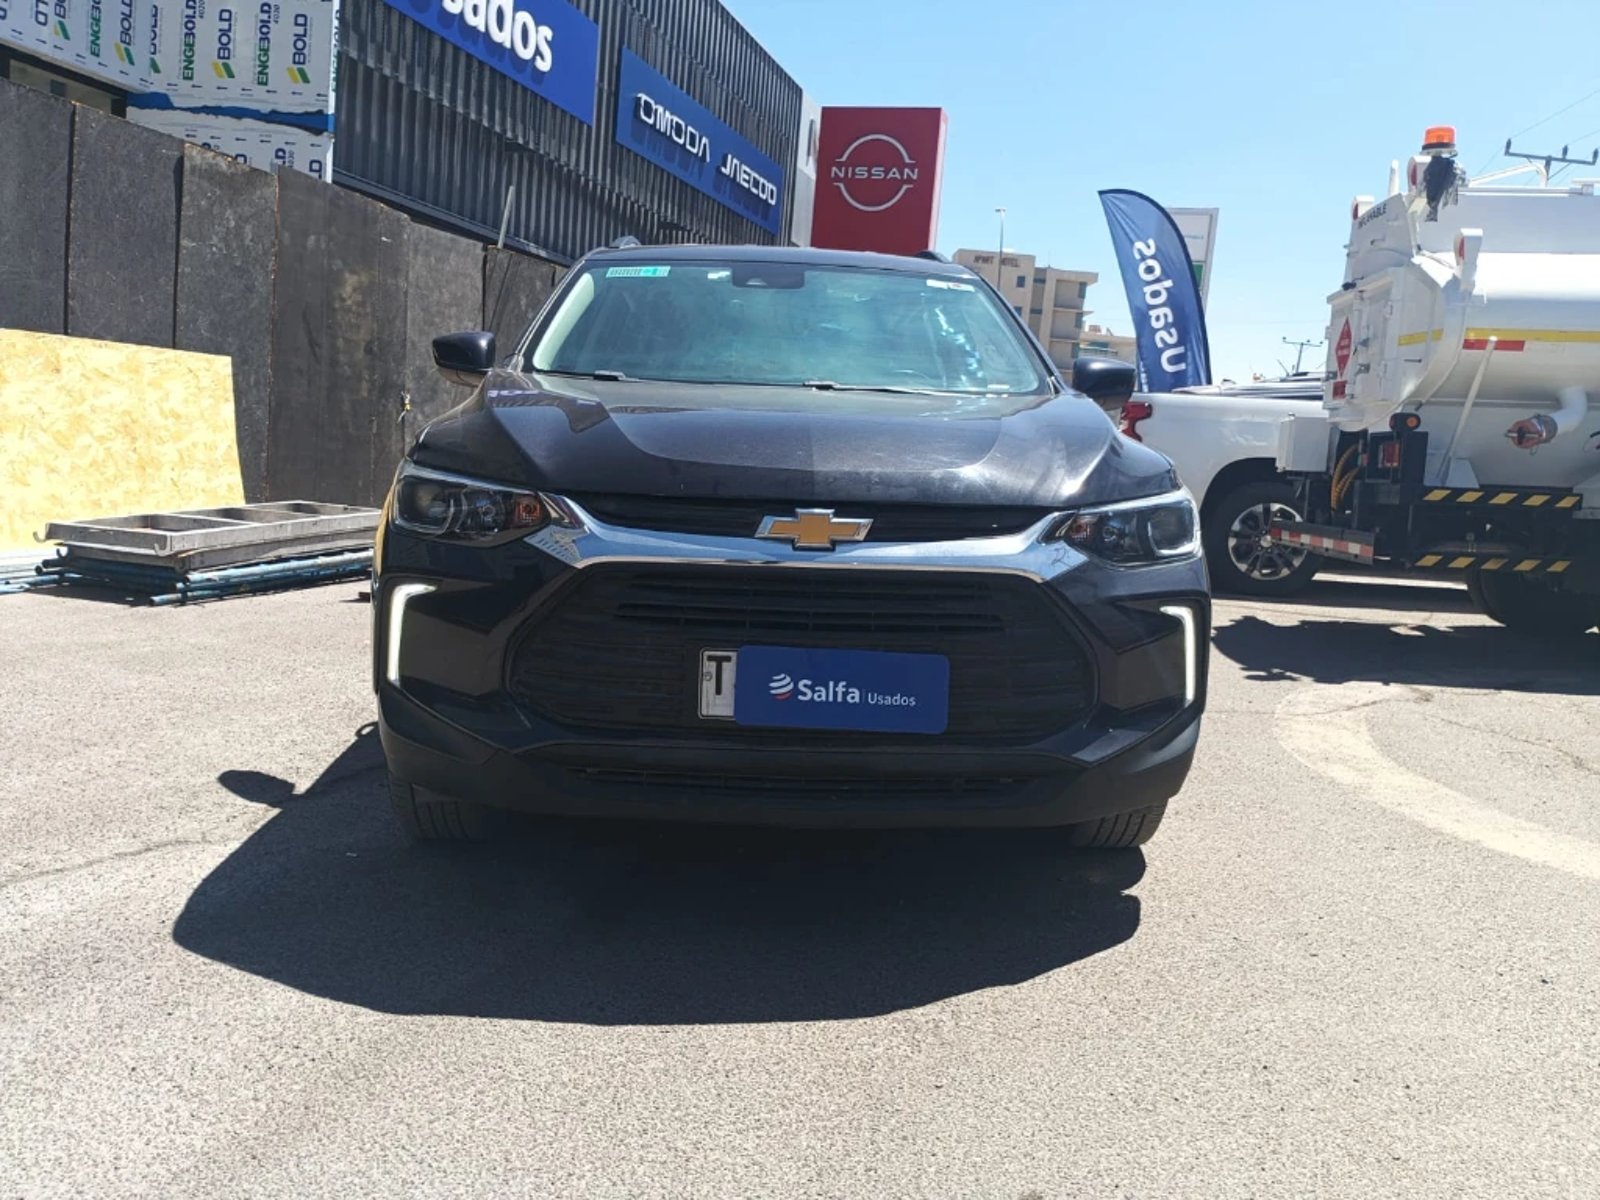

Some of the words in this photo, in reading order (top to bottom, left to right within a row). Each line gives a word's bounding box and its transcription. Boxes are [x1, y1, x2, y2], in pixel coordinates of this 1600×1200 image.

[217, 8, 233, 60] BOLD
[257, 2, 273, 86] ENGEBOLD
[292, 13, 309, 66] BOLD
[636, 92, 711, 163] OMODA
[720, 153, 778, 206] JAECOO
[831, 166, 918, 180] NISSAN
[797, 679, 861, 704] Salfa
[867, 692, 917, 707] Usados
